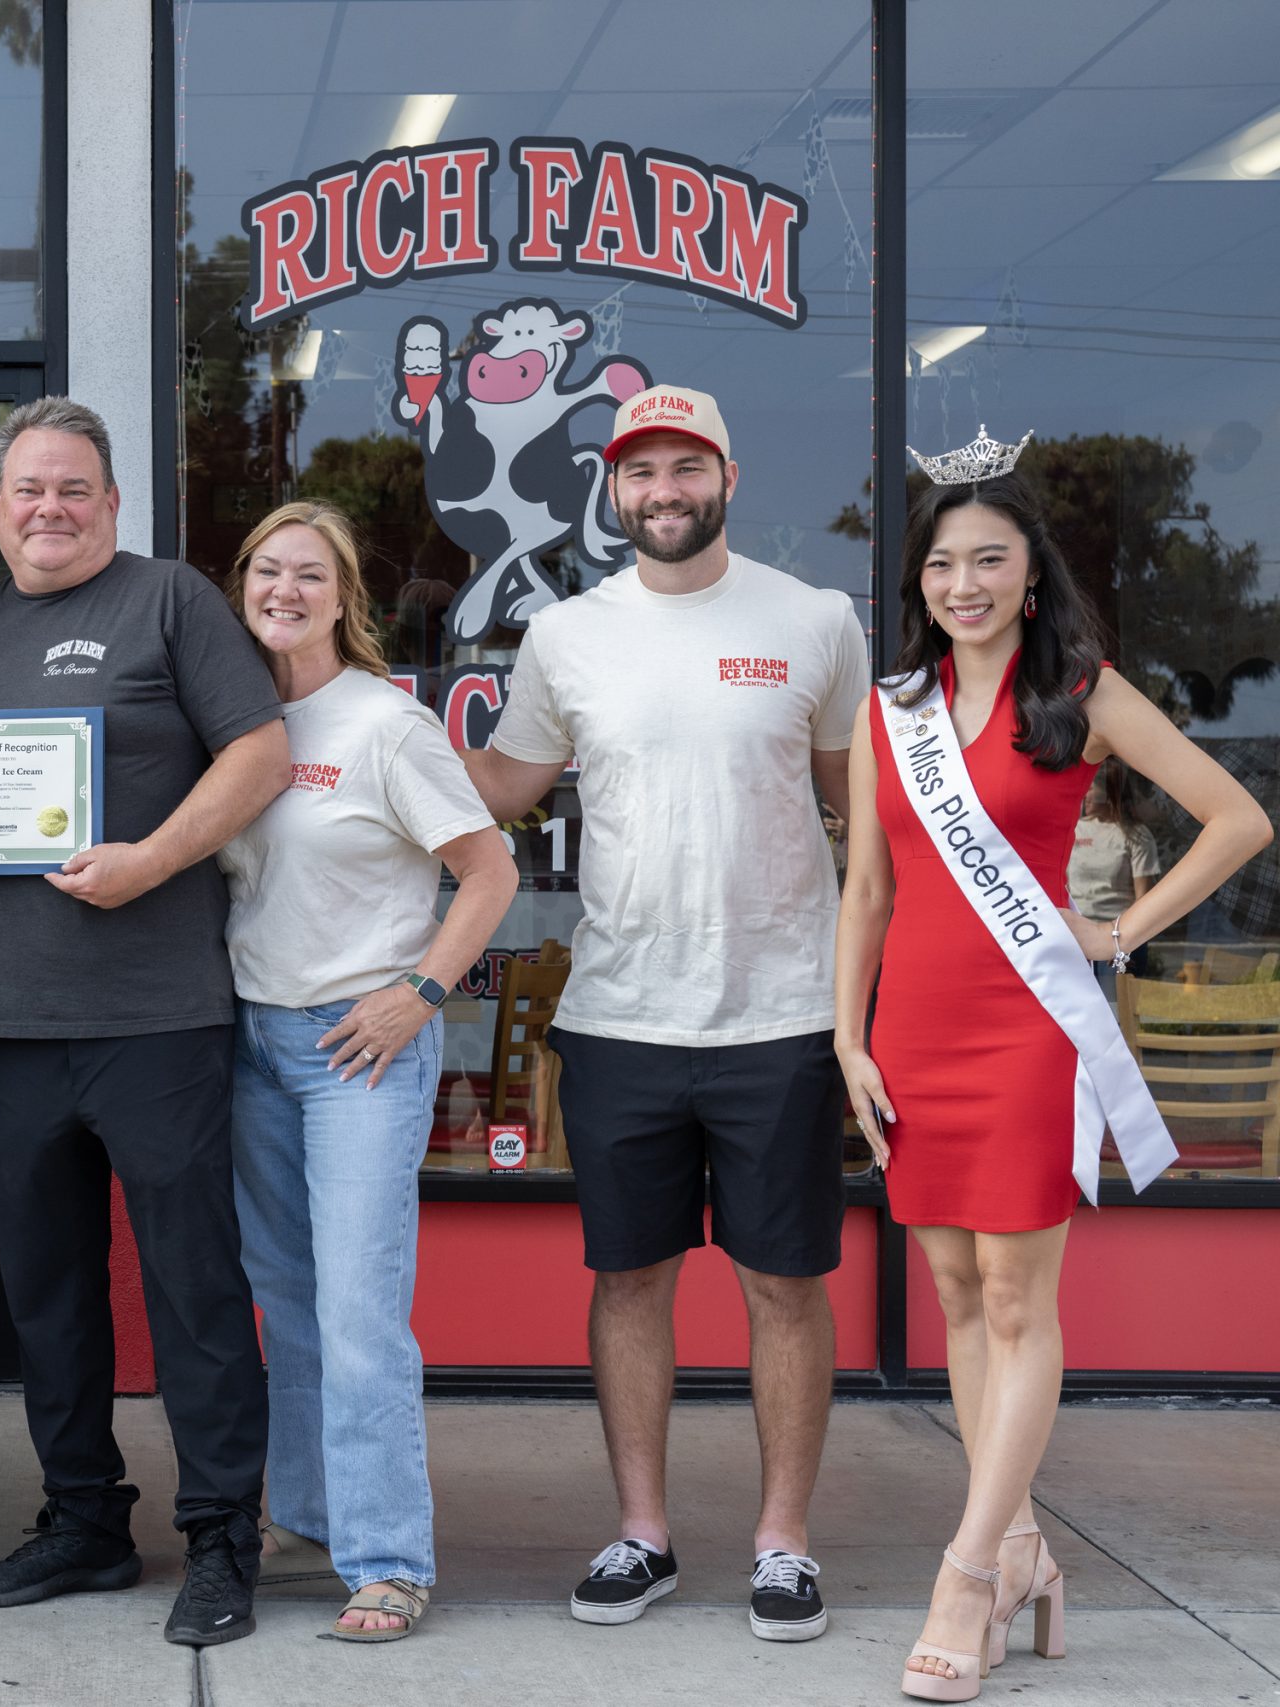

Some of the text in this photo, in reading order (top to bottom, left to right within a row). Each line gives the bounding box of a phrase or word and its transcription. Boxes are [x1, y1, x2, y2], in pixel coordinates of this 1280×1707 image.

[251, 147, 798, 324] RICH FARM
[630, 395, 695, 422] RICH FARM
[636, 411, 687, 426] Ice Cream
[43, 639, 106, 664] RICH FARM
[43, 663, 98, 677] Ice Cream
[719, 658, 788, 671] RICH FARM
[719, 668, 788, 684] ICE CREAM
[730, 680, 769, 688] PLACENTIA,
[4, 742, 58, 754] Recognition
[2, 767, 15, 776] Ice
[17, 767, 43, 776] Cream
[291, 763, 342, 779] ICH FARM
[298, 773, 337, 790] CREAM
[907, 734, 946, 796] Miss
[931, 794, 1043, 948] Placentia
[494, 1140, 520, 1150] BAY
